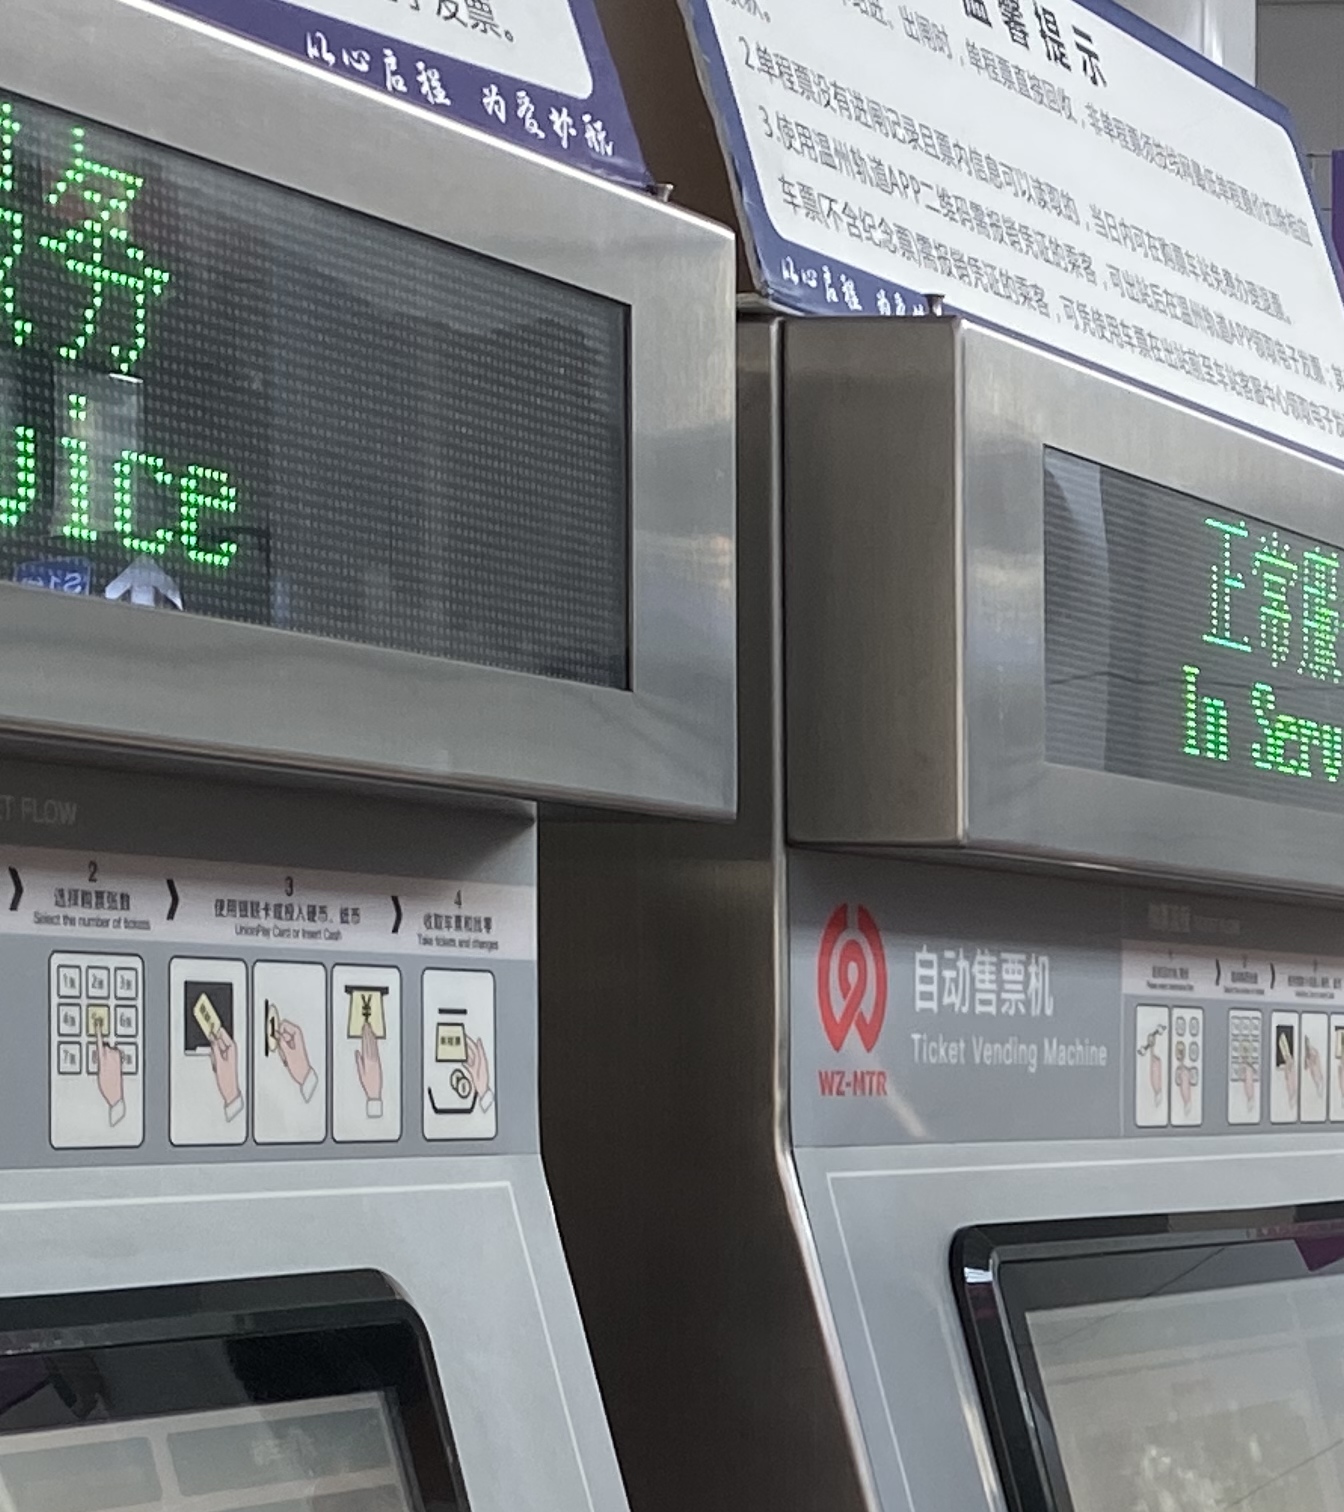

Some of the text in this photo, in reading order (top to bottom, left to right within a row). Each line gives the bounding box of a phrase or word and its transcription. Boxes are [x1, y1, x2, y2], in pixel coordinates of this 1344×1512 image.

[21, 797, 78, 826] FLOW
[88, 860, 98, 883] 2
[284, 876, 294, 897] 3
[454, 890, 463, 909] 4
[33, 910, 61, 926] Select
[78, 914, 111, 929] number
[914, 944, 1054, 1017] 自动售票机
[910, 1032, 1108, 1073] Ticket Vending Machine
[817, 1070, 888, 1097] WZ-MTR
